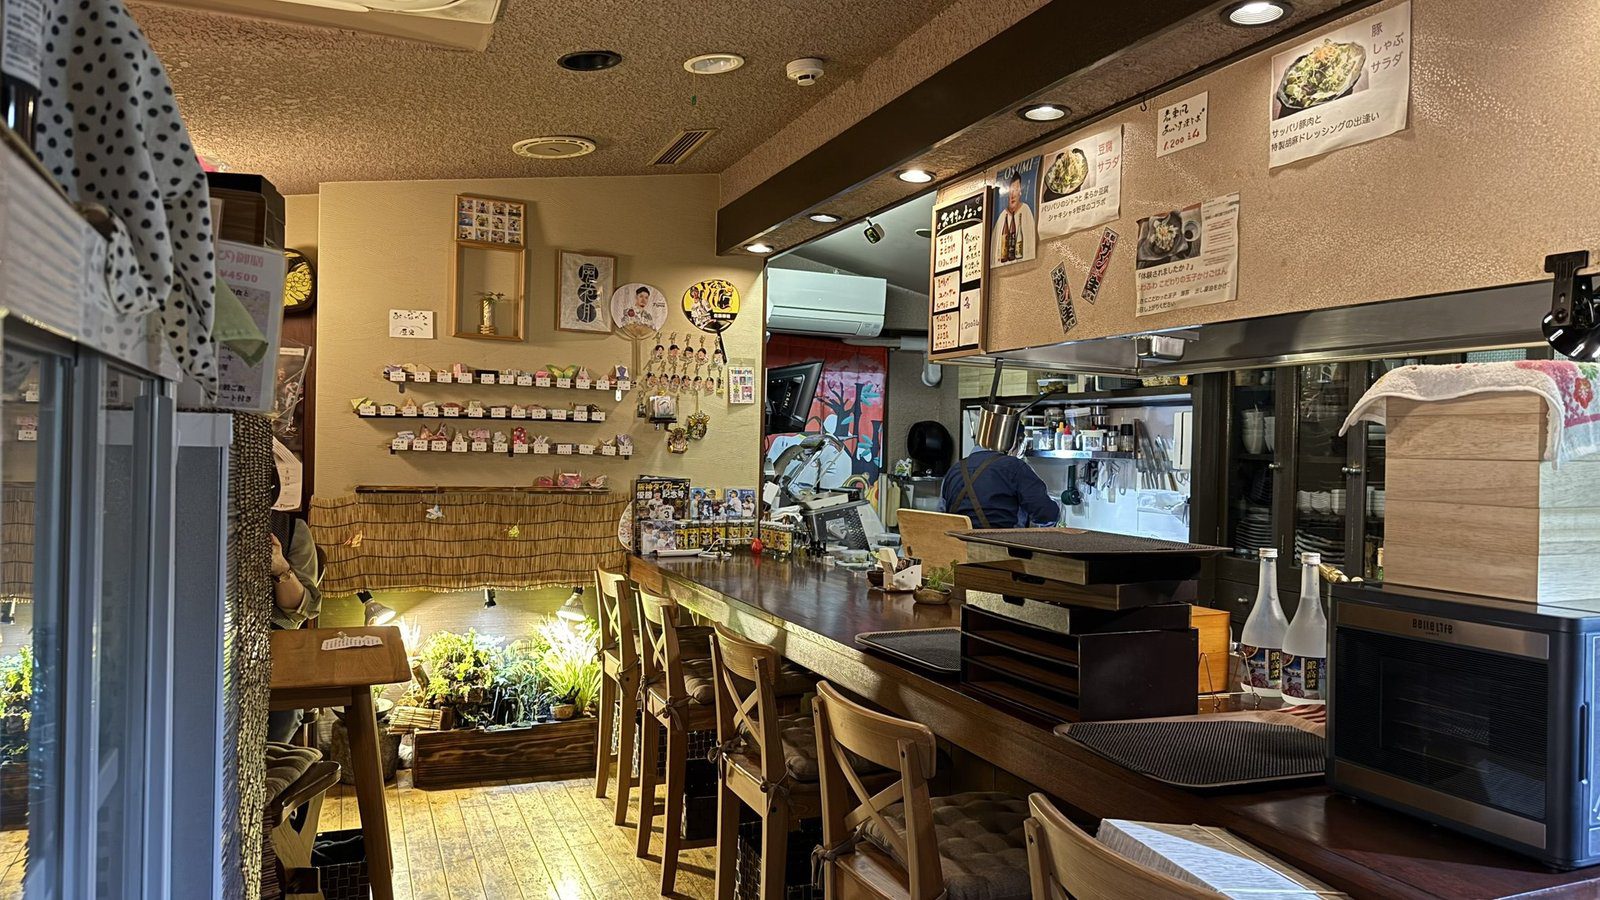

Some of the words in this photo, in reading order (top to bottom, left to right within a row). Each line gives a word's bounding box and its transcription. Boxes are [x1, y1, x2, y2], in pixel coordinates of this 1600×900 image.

[1371, 22, 1383, 38] 豚
[1373, 32, 1404, 55] しゃぶ
[1371, 52, 1404, 73] サラダ
[1271, 112, 1380, 152] 特製胡麻ドレッシングの出逢い
[1272, 115, 1322, 138] サッパリ豚肉と
[1098, 141, 1113, 156] 豆腐
[1098, 154, 1120, 173] サラダ
[637, 482, 685, 491] 阪神タイガース
[664, 511, 670, 519] 3
